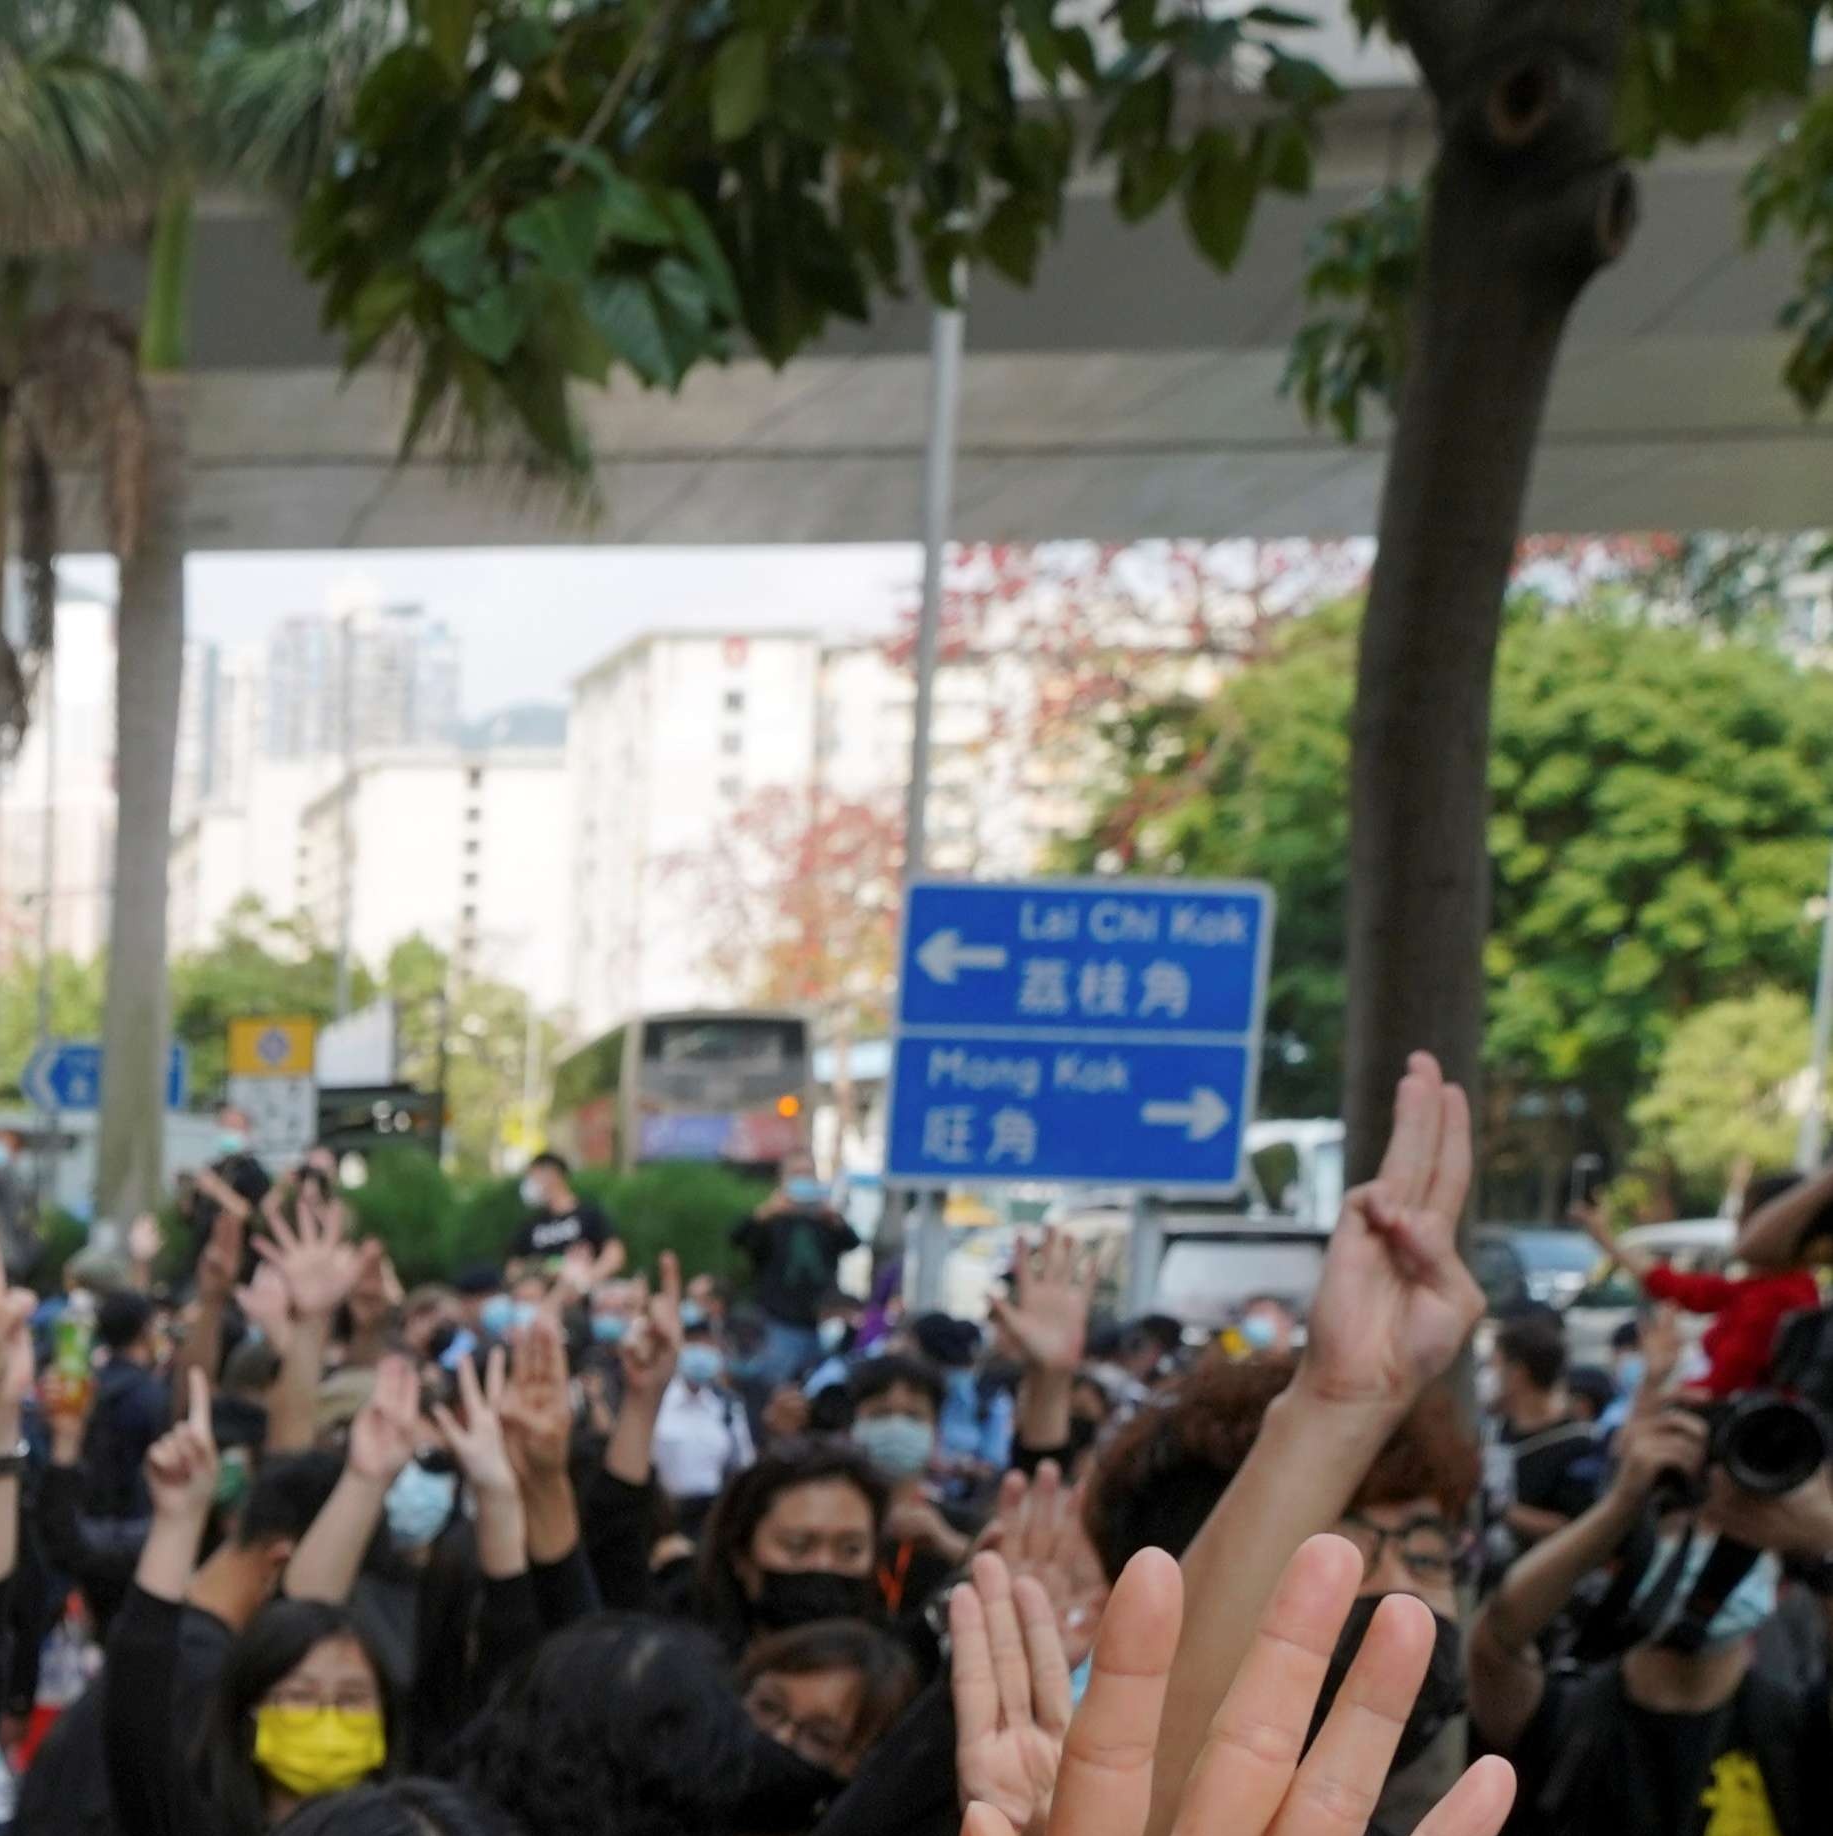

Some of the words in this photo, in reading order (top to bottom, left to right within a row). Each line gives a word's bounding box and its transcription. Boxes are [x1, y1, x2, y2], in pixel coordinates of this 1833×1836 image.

[1019, 899, 1080, 941] Lai
[1088, 900, 1160, 943] Chi
[1170, 903, 1247, 946] Kok
[928, 1048, 1041, 1098] Mong
[1053, 1051, 1130, 1093] Kok
[922, 1105, 1037, 1165] 旺角
